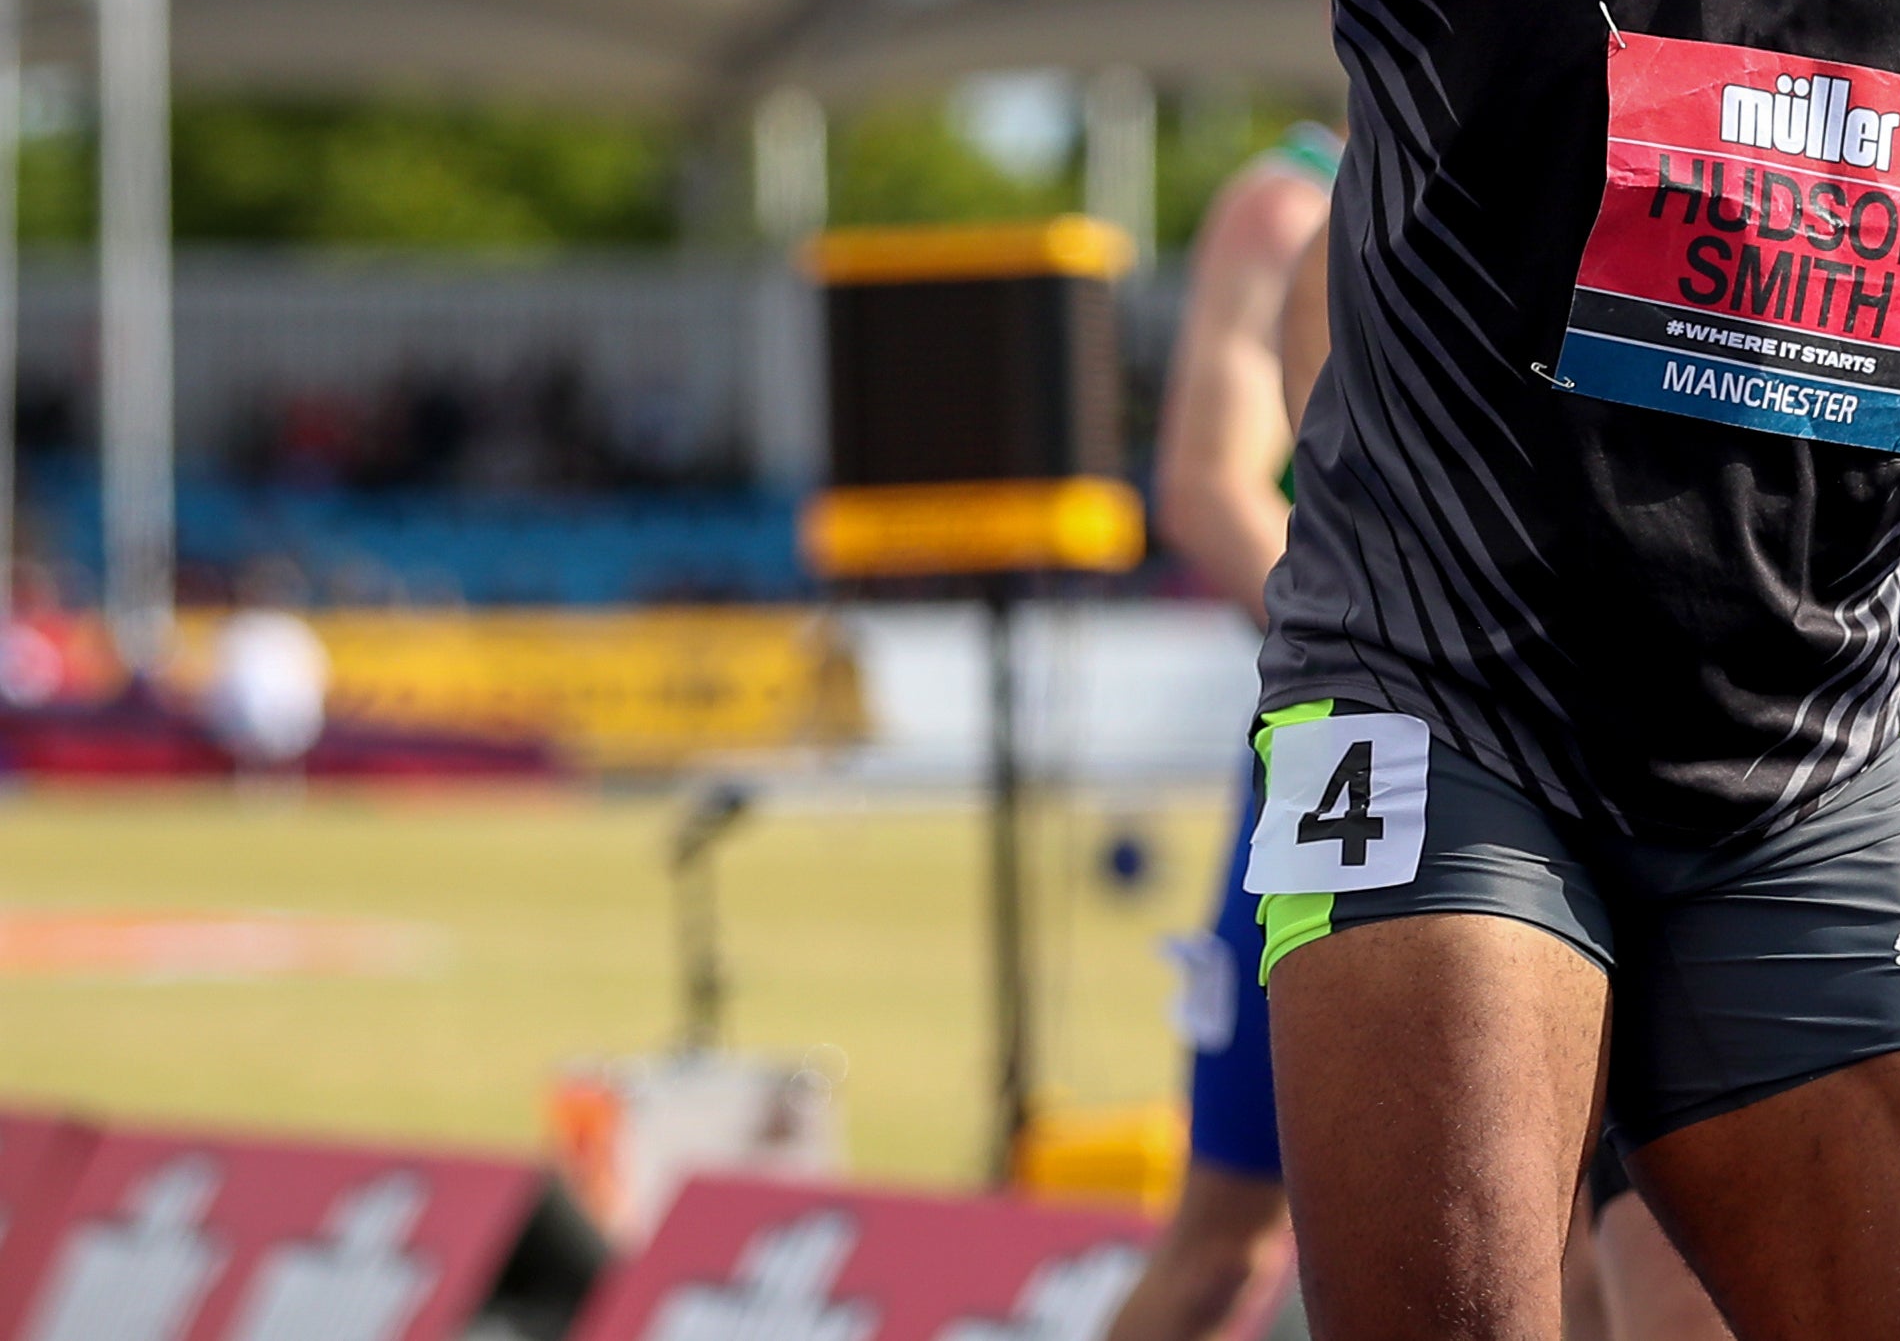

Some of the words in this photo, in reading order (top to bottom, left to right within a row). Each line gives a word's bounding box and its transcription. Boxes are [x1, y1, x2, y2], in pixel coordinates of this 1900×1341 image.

[1719, 73, 1900, 172] müller
[1678, 235, 1895, 339] SMITH
[1662, 361, 1858, 424] MANCHESTER
[1666, 319, 1777, 355] #WHERE
[1779, 341, 1802, 360] IT
[1801, 346, 1878, 374] STARTS
[1296, 740, 1384, 866] 4
